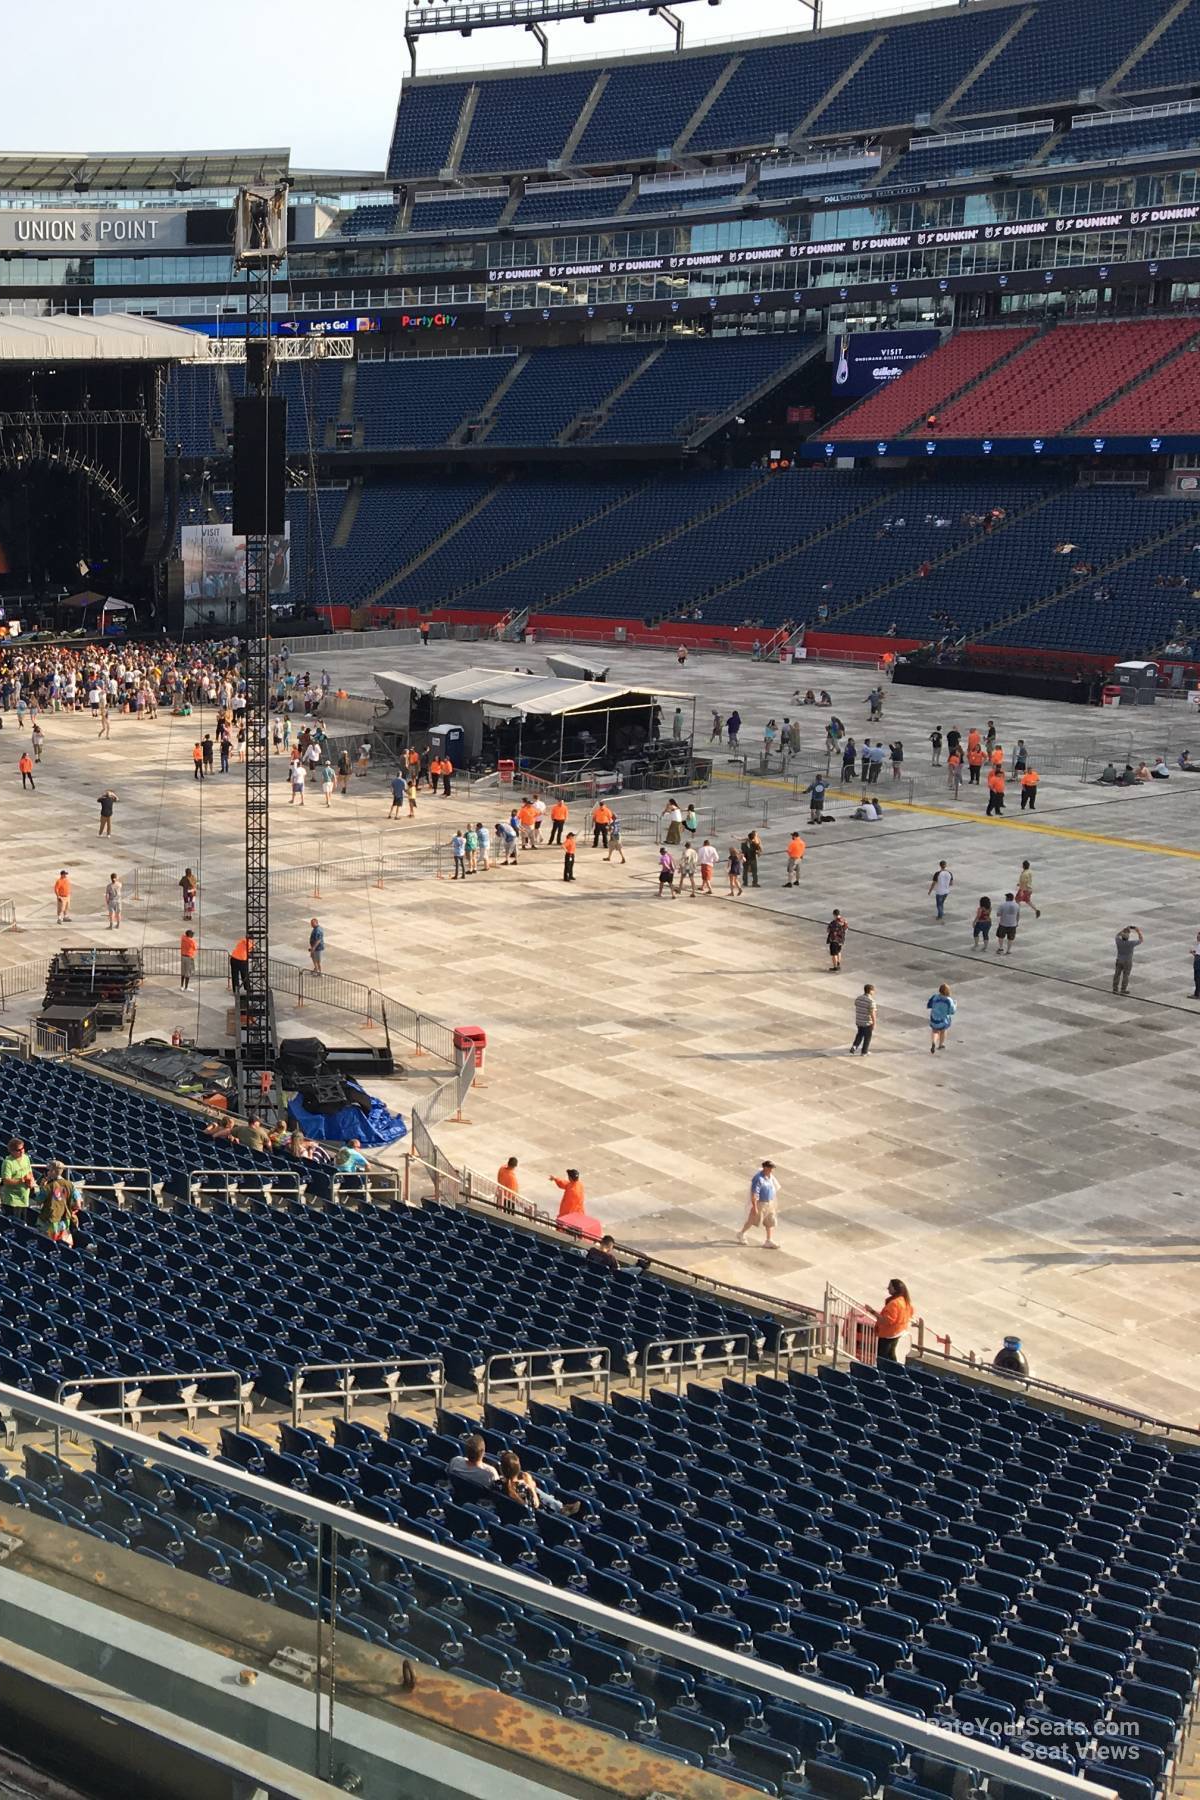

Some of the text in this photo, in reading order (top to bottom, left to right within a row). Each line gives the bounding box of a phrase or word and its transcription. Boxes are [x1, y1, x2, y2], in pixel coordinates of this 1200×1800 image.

[1151, 207, 1200, 221] DUNKIN'
[1076, 215, 1122, 228] DUNKIN'
[18, 220, 159, 240] UNION POINT
[1003, 222, 1048, 235] DUNKIN'
[869, 236, 911, 248] DUNKIN'
[936, 230, 979, 242] DUNKIN'
[745, 249, 784, 260] DUNKIN'
[807, 243, 846, 255] DUNKIN'
[625, 259, 664, 270] DUNKIN'
[687, 254, 723, 266] DUNKIN'
[505, 268, 543, 279] DUNKIN'
[566, 264, 604, 275] DUNKIN'
[310, 320, 349, 331] Let's Go!
[402, 313, 458, 328] Party City
[881, 348, 903, 356] VISIT
